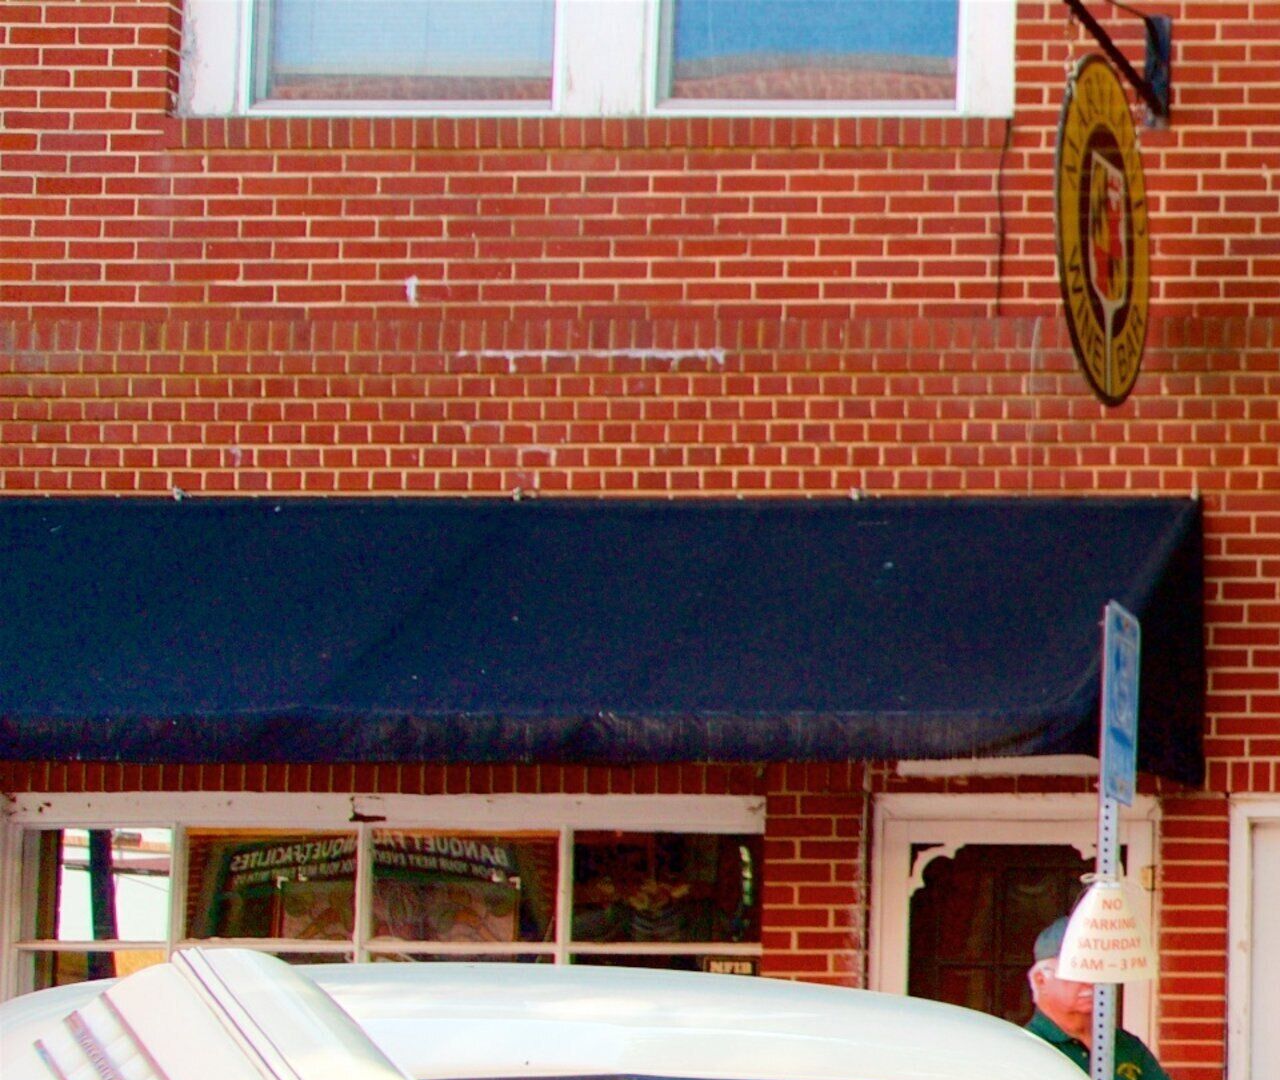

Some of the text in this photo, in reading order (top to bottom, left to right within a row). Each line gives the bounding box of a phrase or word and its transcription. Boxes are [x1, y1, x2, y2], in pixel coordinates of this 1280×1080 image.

[1067, 246, 1145, 384] WINE BAR
[1101, 897, 1124, 911] NO
[1085, 916, 1137, 930] PARKING
[1078, 937, 1141, 951] SATURDAY
[1080, 958, 1105, 970] AM
[1130, 956, 1148, 969] PM
